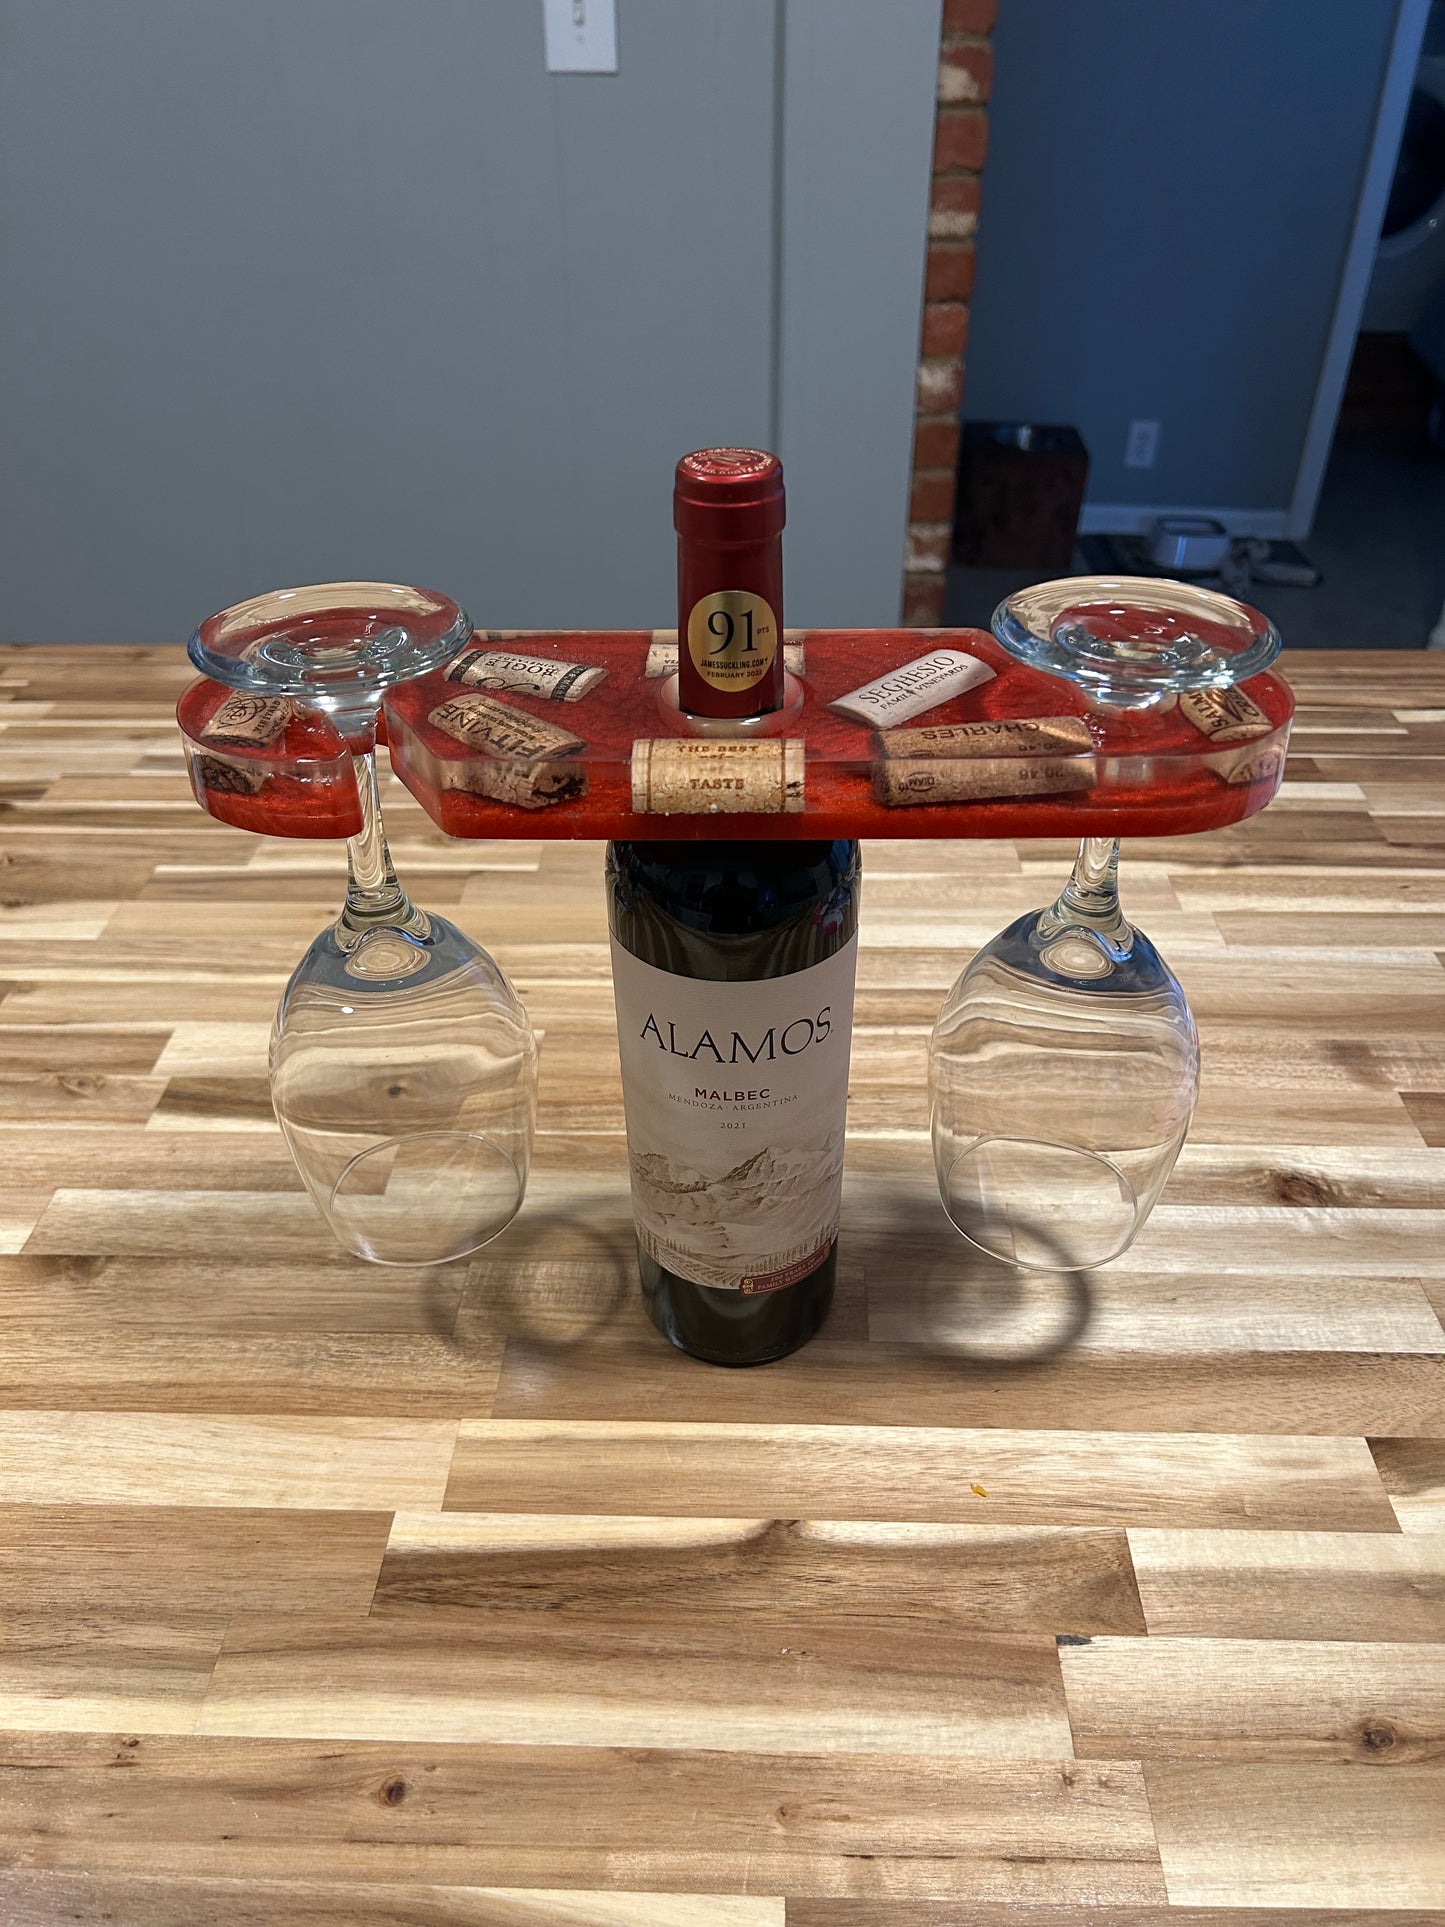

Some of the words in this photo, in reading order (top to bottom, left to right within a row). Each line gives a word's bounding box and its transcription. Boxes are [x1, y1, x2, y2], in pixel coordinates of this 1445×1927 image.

[707, 609, 758, 655] 91
[485, 658, 556, 677] BOGLE
[700, 658, 764, 670] JAMESSUCKLING.COM
[706, 671, 745, 679] FEBRUARY
[746, 670, 763, 678] 2022
[858, 656, 955, 704] SEGHESIO
[914, 664, 969, 691] VINEYARDS
[436, 703, 547, 758] FITVINE
[919, 722, 1040, 740] CHARLES
[717, 745, 759, 753] BEST
[689, 778, 745, 790] TASTE
[639, 1006, 832, 1064] ALAMOS
[668, 1092, 724, 1111] MENDOZA
[732, 1094, 800, 1111] ARGENTINA
[694, 1087, 771, 1101] MALBEC
[719, 1121, 747, 1130] 2021
[757, 1279, 784, 1290] FAMILY
